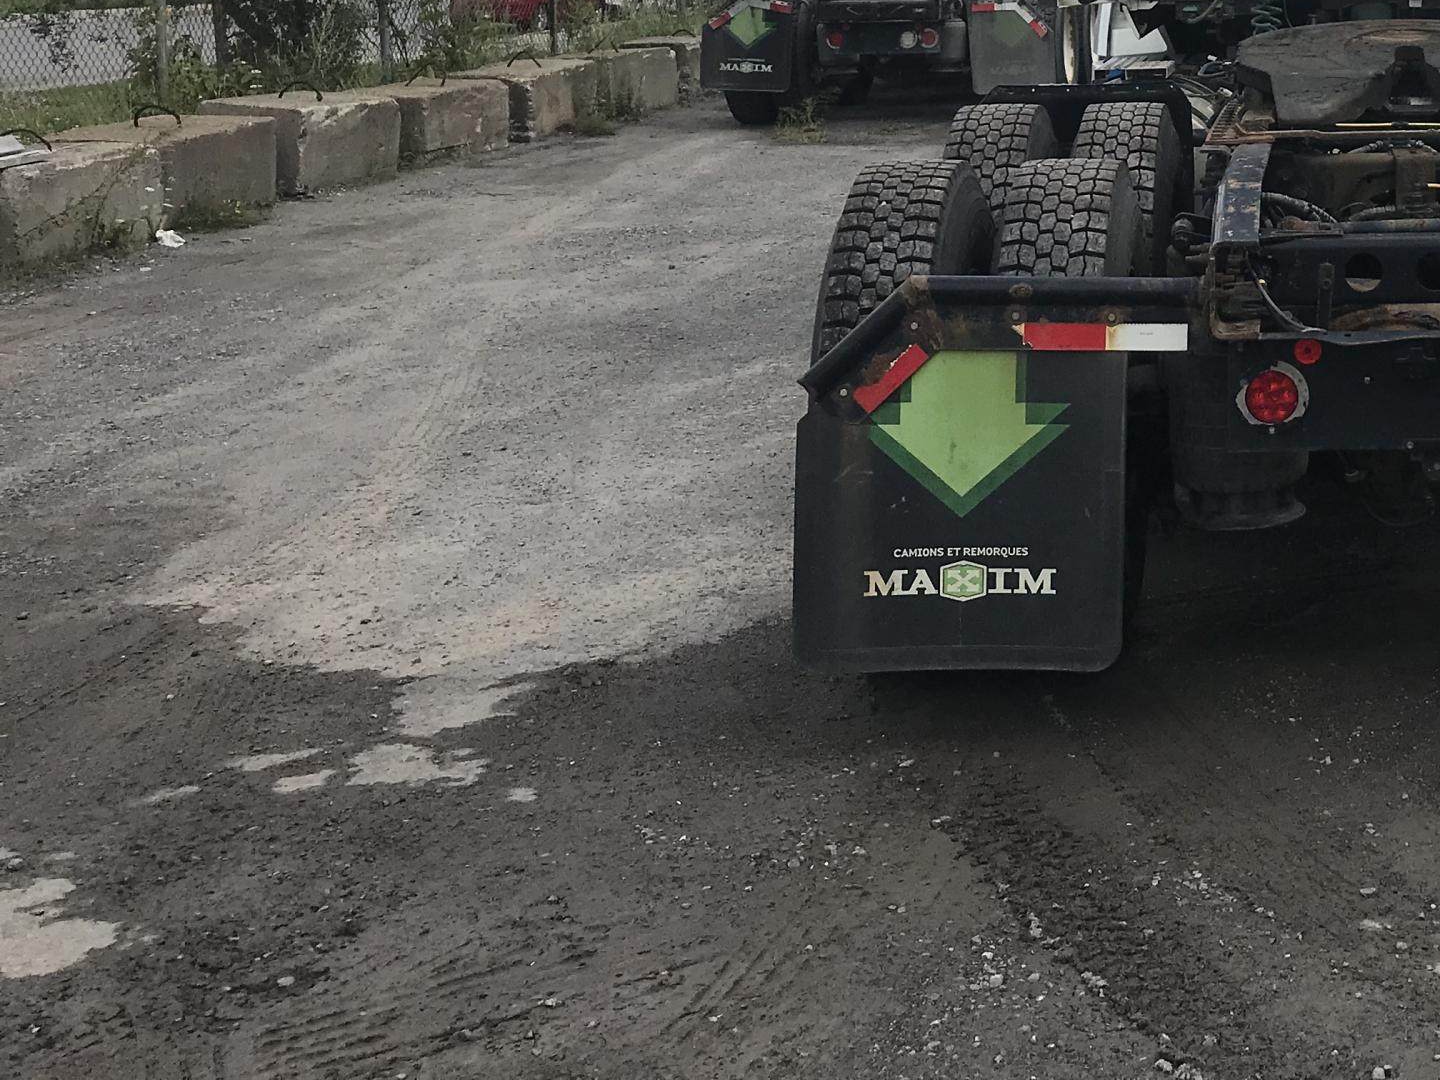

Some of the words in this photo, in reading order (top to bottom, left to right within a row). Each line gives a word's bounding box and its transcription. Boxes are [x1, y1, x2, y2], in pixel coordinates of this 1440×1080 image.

[719, 61, 773, 73] MAXIM
[893, 547, 945, 558] CAMIONS
[947, 547, 961, 557] ET
[963, 546, 1029, 558] REMORQUES
[863, 560, 1057, 602] MAXIM
